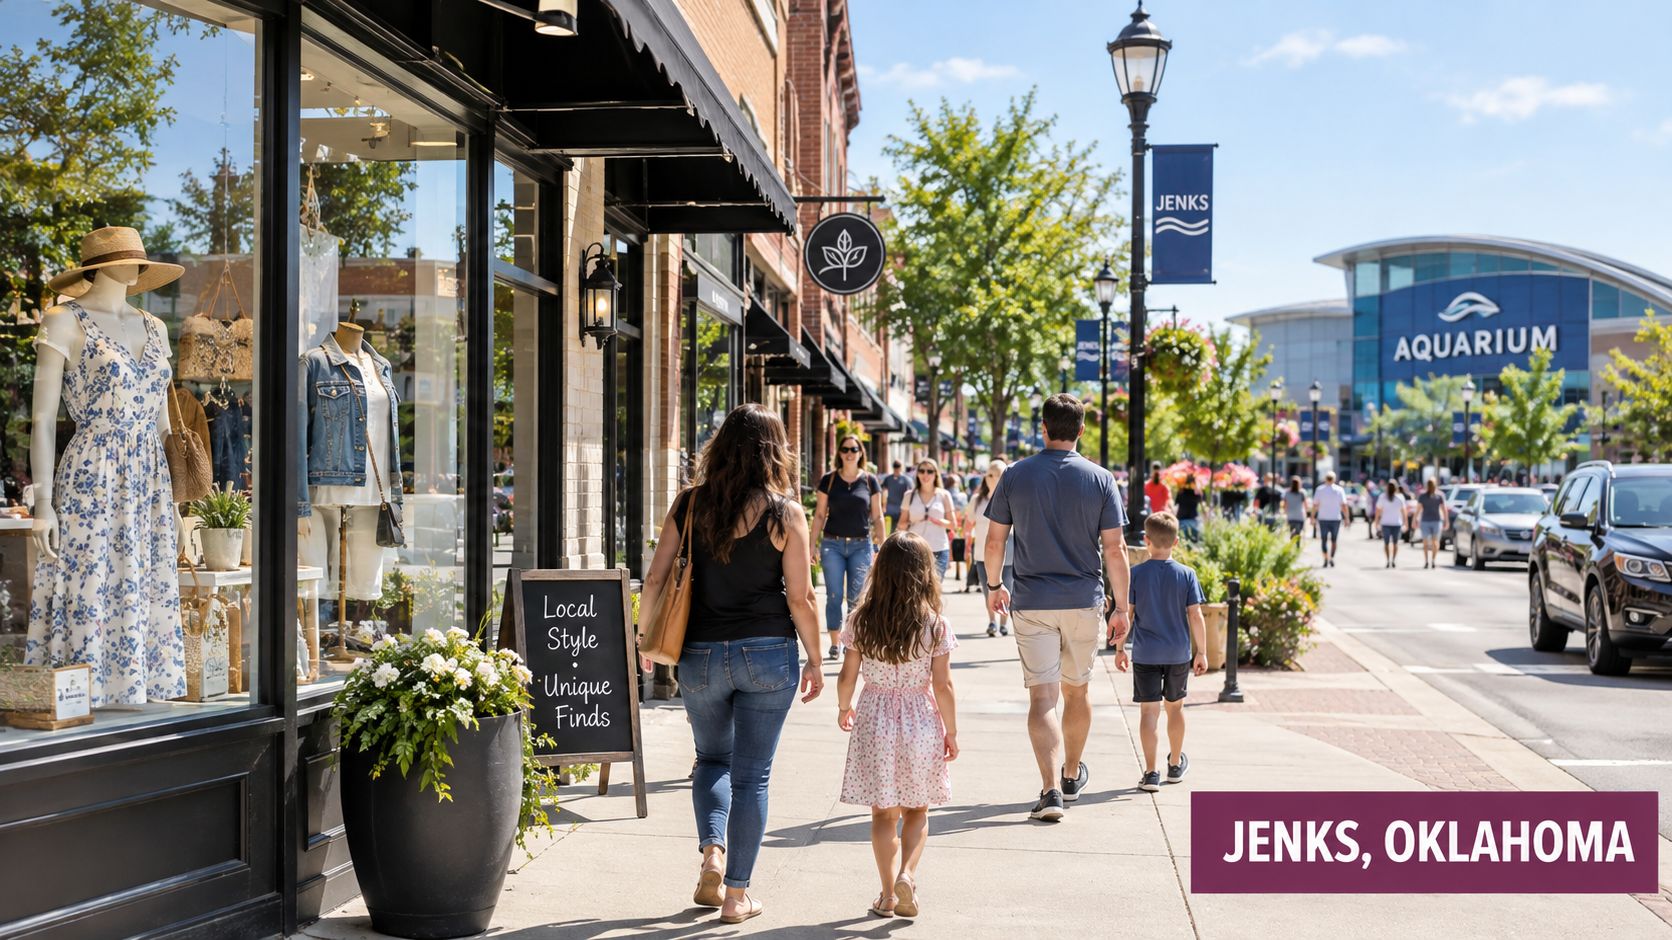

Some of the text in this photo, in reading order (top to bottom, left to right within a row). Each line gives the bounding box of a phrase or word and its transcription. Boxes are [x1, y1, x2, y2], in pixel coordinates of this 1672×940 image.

[1156, 194, 1209, 211] JENKS
[1394, 325, 1558, 362] AQUARIUM
[543, 594, 598, 619] Local
[547, 626, 599, 657] Style
[544, 673, 612, 704] Unique
[555, 704, 611, 730] Finds
